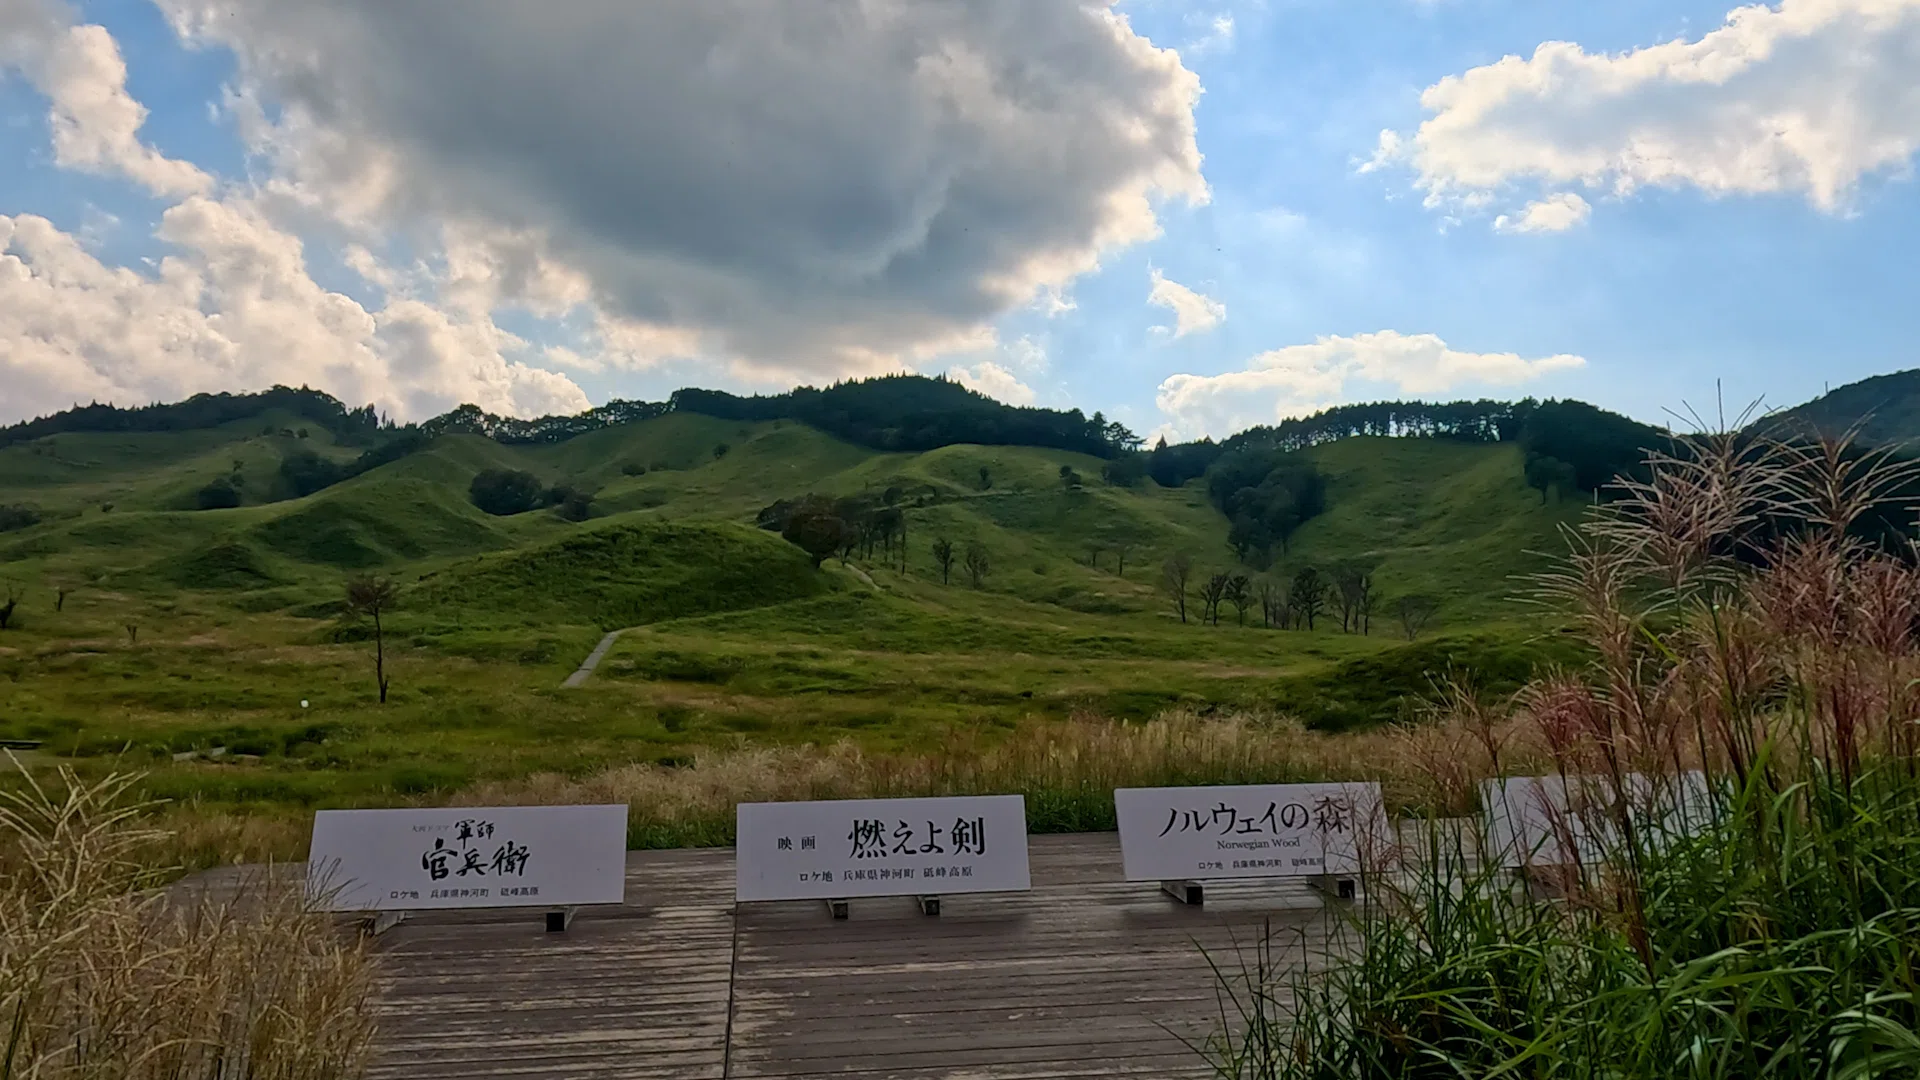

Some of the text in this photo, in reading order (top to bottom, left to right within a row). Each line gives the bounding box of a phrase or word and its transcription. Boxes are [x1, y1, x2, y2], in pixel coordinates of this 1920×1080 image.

[1158, 796, 1351, 837] ノルウェイの森
[454, 819, 495, 849] 軍師
[847, 817, 986, 859] 燃えよ剣
[1216, 837, 1301, 851] Norwegian Wood
[422, 838, 531, 881] 官兵衛
[1198, 861, 1224, 870] ロケ地
[799, 870, 834, 883] ロケ地
[843, 867, 916, 881] 兵庫県神河町
[389, 889, 420, 900] ロケ地
